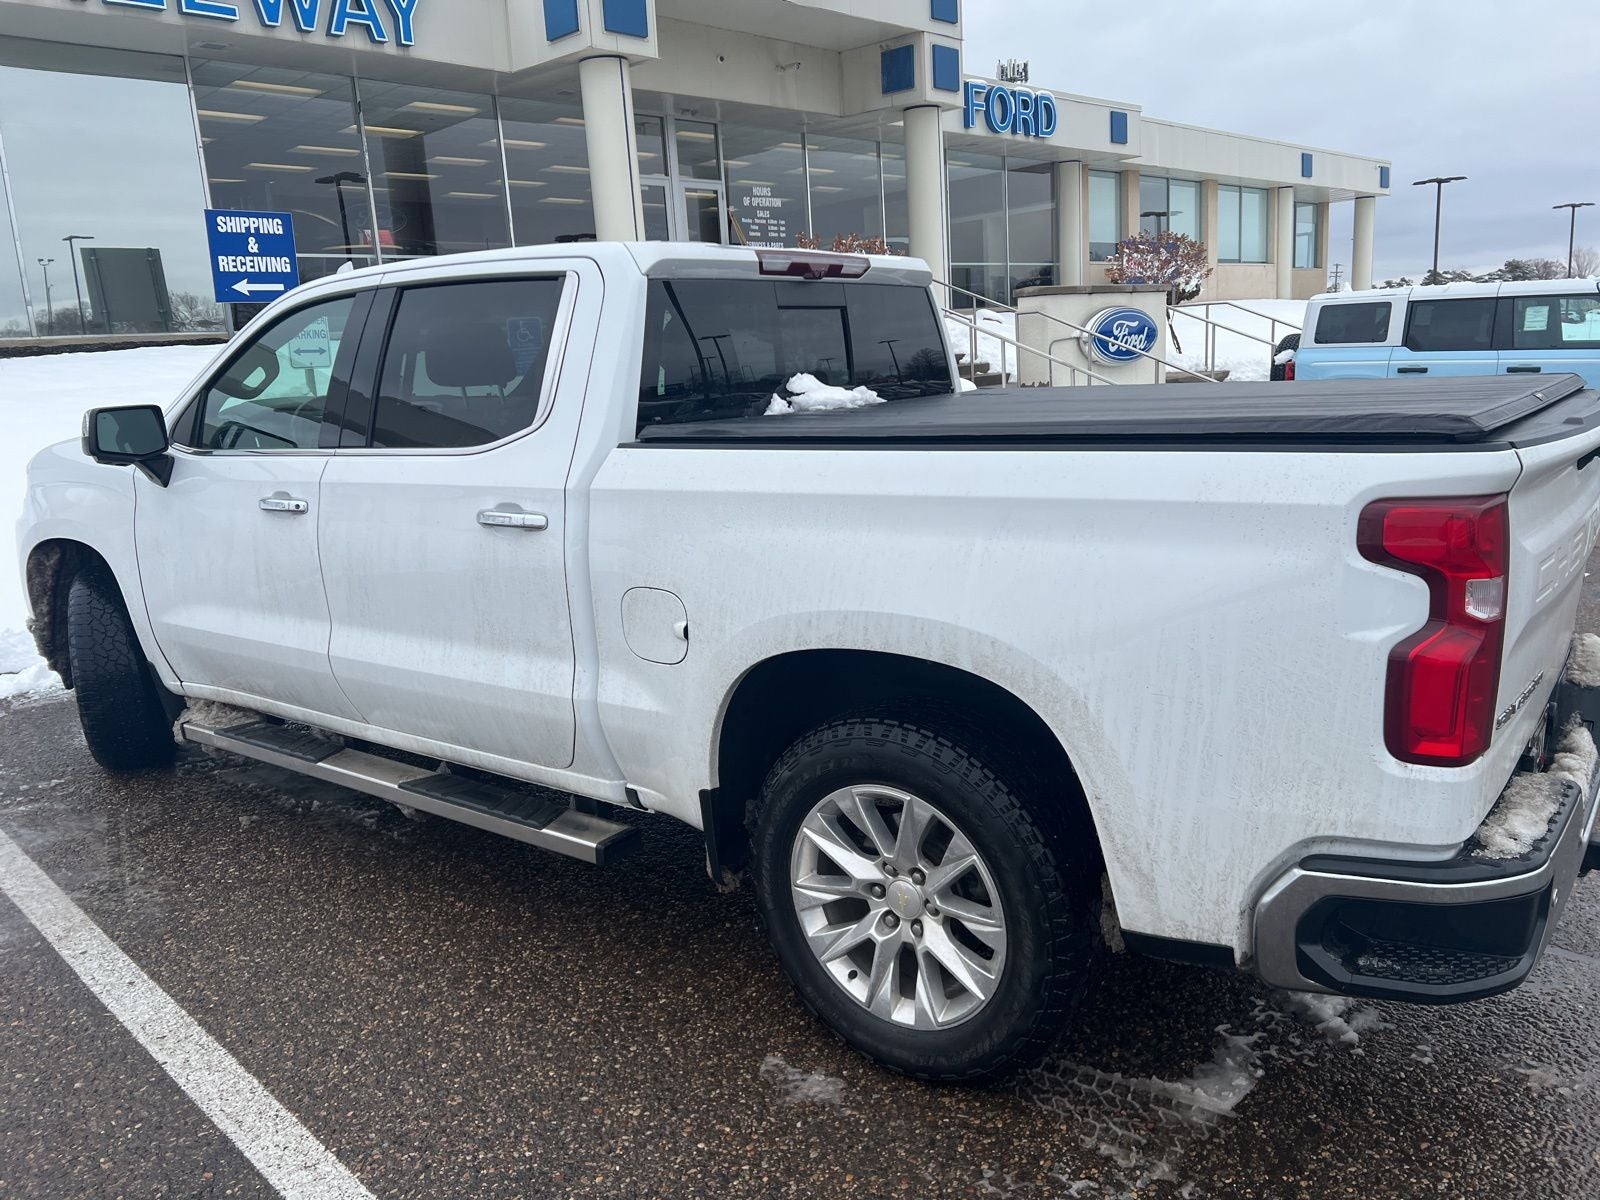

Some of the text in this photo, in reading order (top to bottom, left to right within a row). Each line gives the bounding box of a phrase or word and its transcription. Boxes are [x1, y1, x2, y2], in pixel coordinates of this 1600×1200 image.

[964, 80, 1057, 138] FORD
[752, 186, 771, 196] HOURS
[743, 197, 781, 207] OF OPERATION
[216, 215, 284, 234] SHIPPING
[247, 236, 259, 253] &
[217, 255, 291, 273] RECEIVING
[294, 329, 327, 340] RKING
[1108, 320, 1149, 353] Ford
